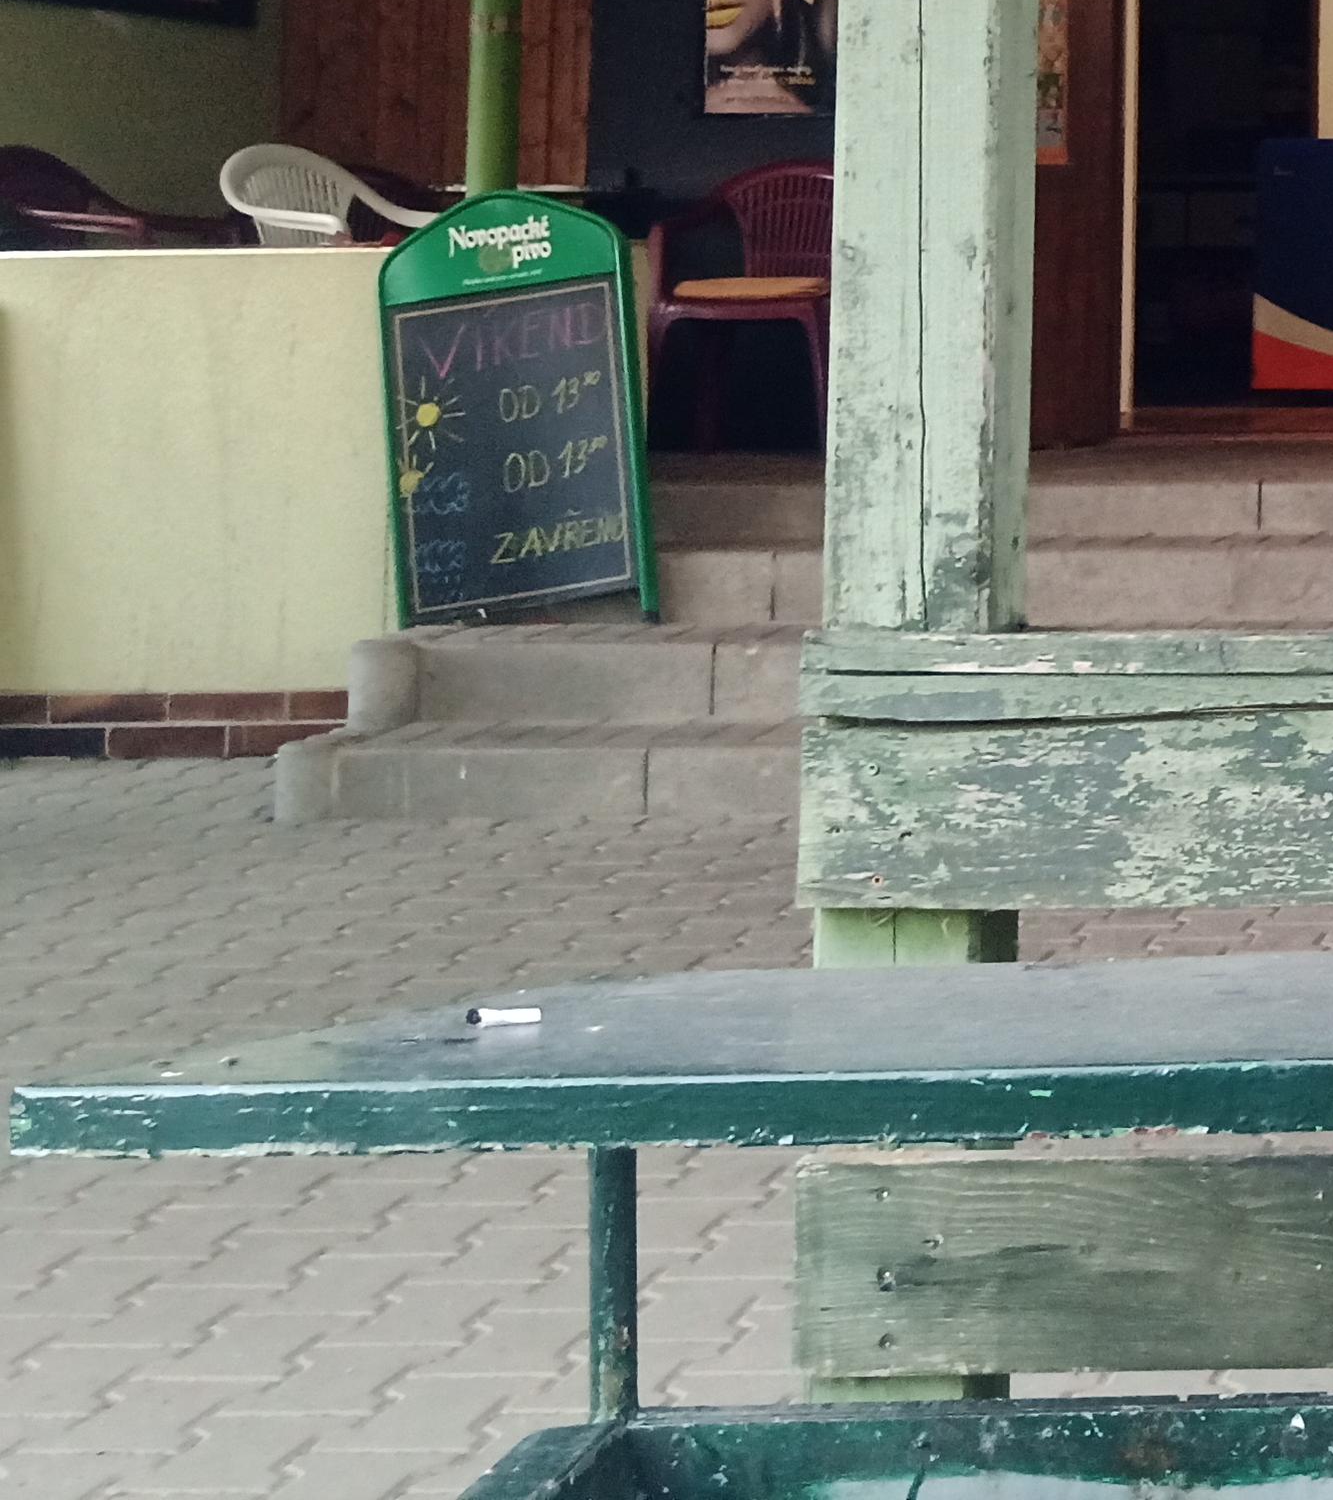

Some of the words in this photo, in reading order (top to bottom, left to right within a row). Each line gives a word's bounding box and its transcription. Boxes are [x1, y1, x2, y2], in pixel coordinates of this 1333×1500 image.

[447, 214, 550, 258] Novopacké
[511, 240, 551, 268] pivo
[498, 384, 540, 422] OD
[502, 449, 550, 492] OD
